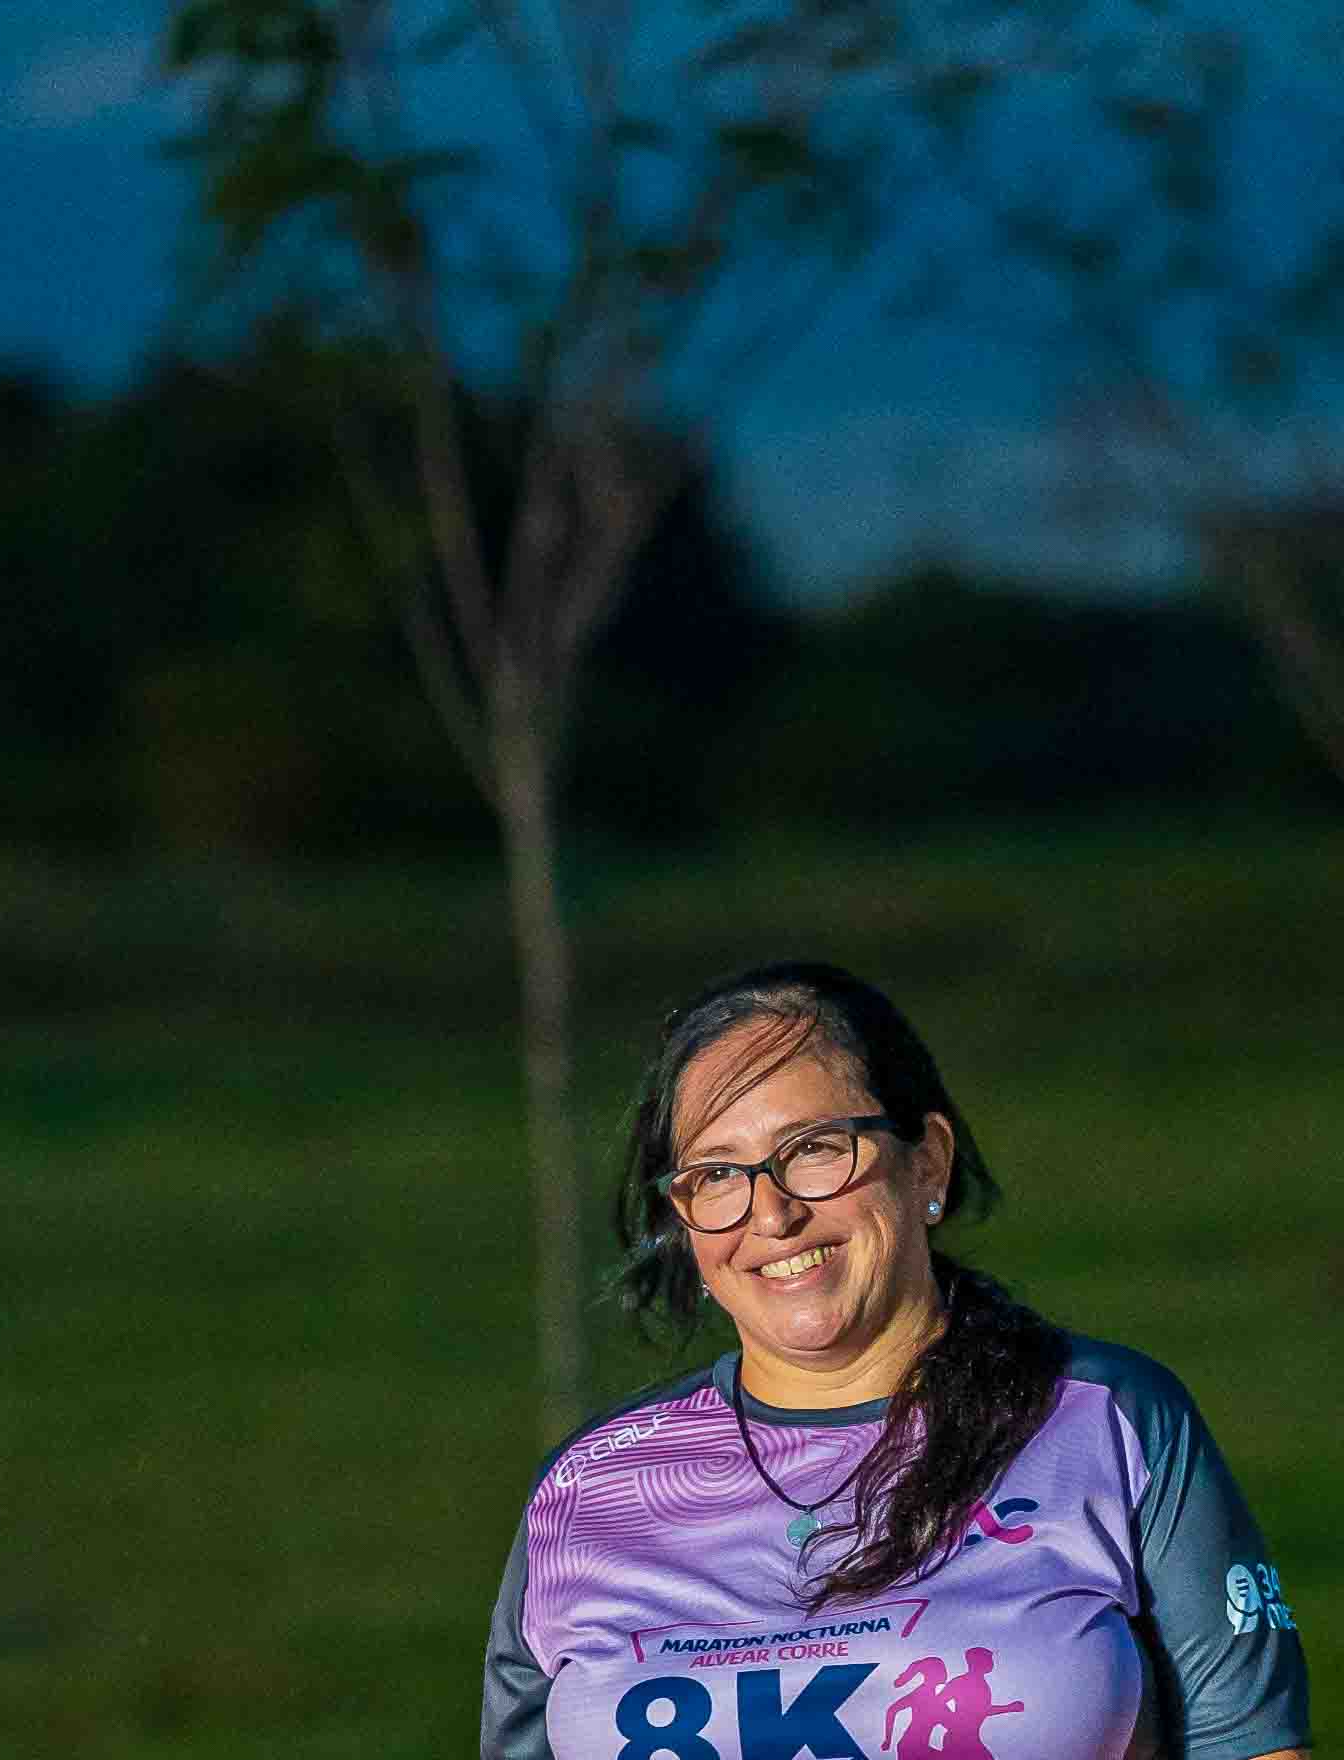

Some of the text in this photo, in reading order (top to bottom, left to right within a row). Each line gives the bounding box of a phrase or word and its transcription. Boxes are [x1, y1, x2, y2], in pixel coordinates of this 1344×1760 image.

[659, 1616, 892, 1653] MARATON NOCTURNA
[688, 1641, 849, 1669] ALVEAR CORRE
